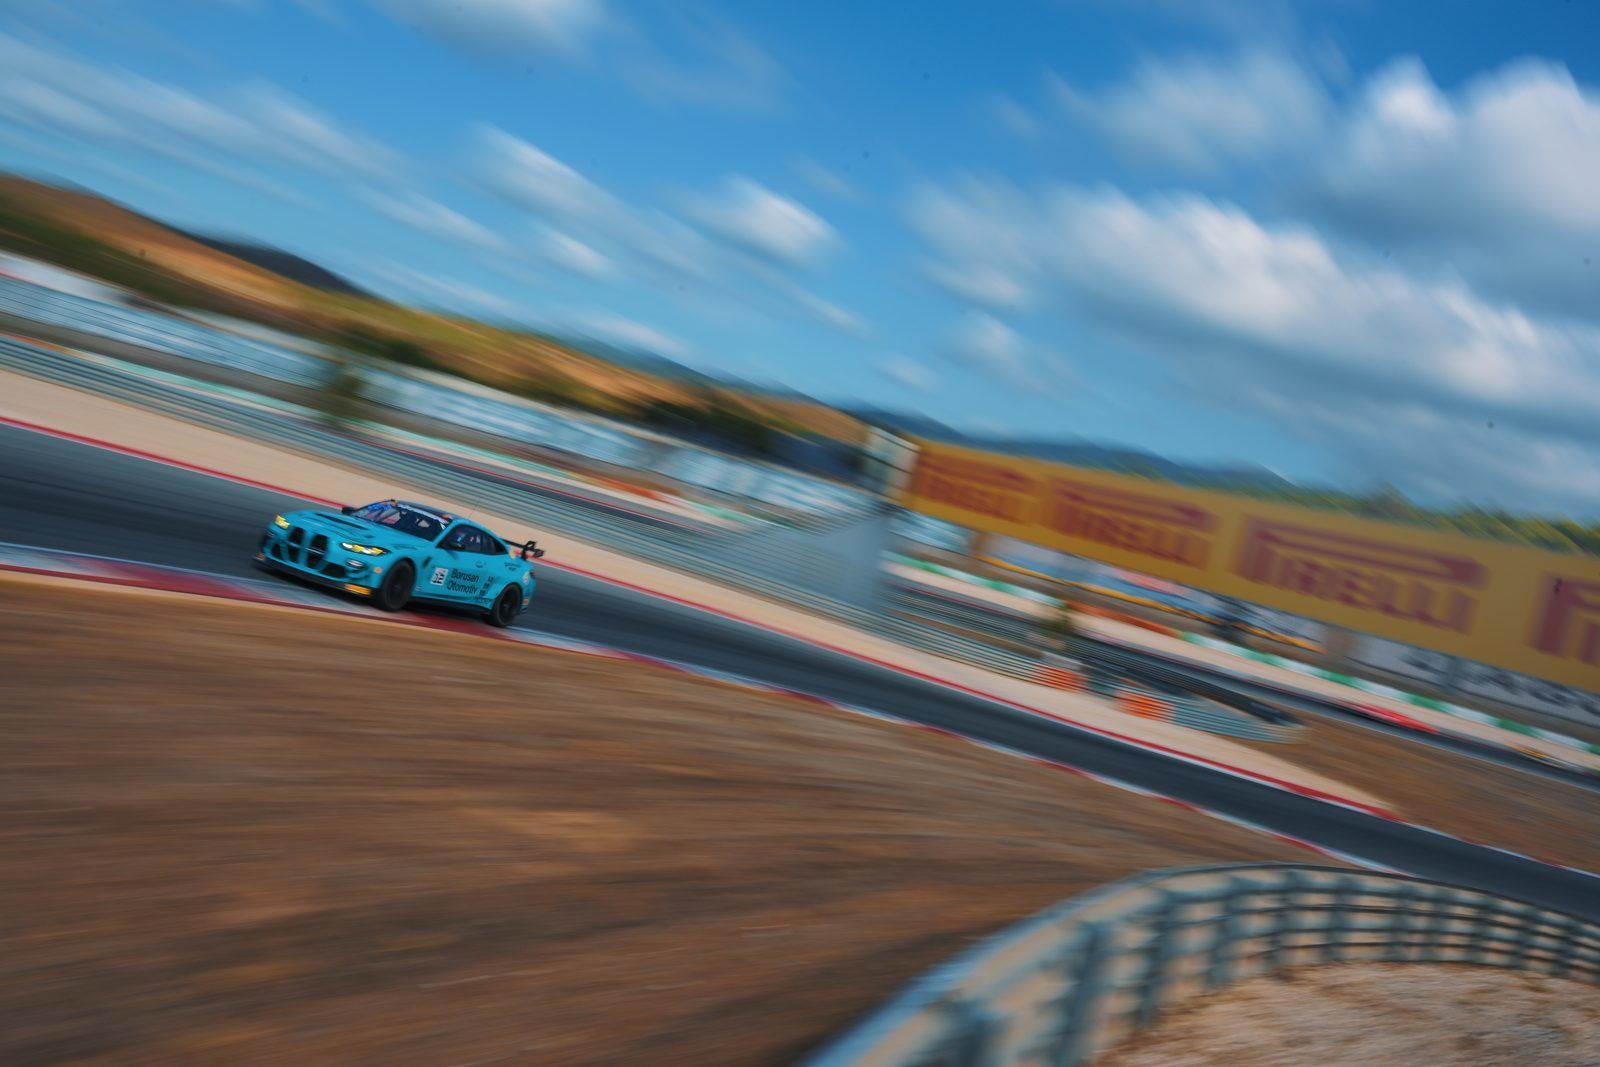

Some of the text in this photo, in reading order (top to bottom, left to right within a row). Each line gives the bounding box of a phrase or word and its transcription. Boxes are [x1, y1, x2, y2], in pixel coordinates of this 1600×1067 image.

[1046, 474, 1216, 570] PIRELLI
[447, 580, 478, 594] Otomotiv
[451, 568, 479, 583] Borusan
[1231, 514, 1488, 637] PIRELLI
